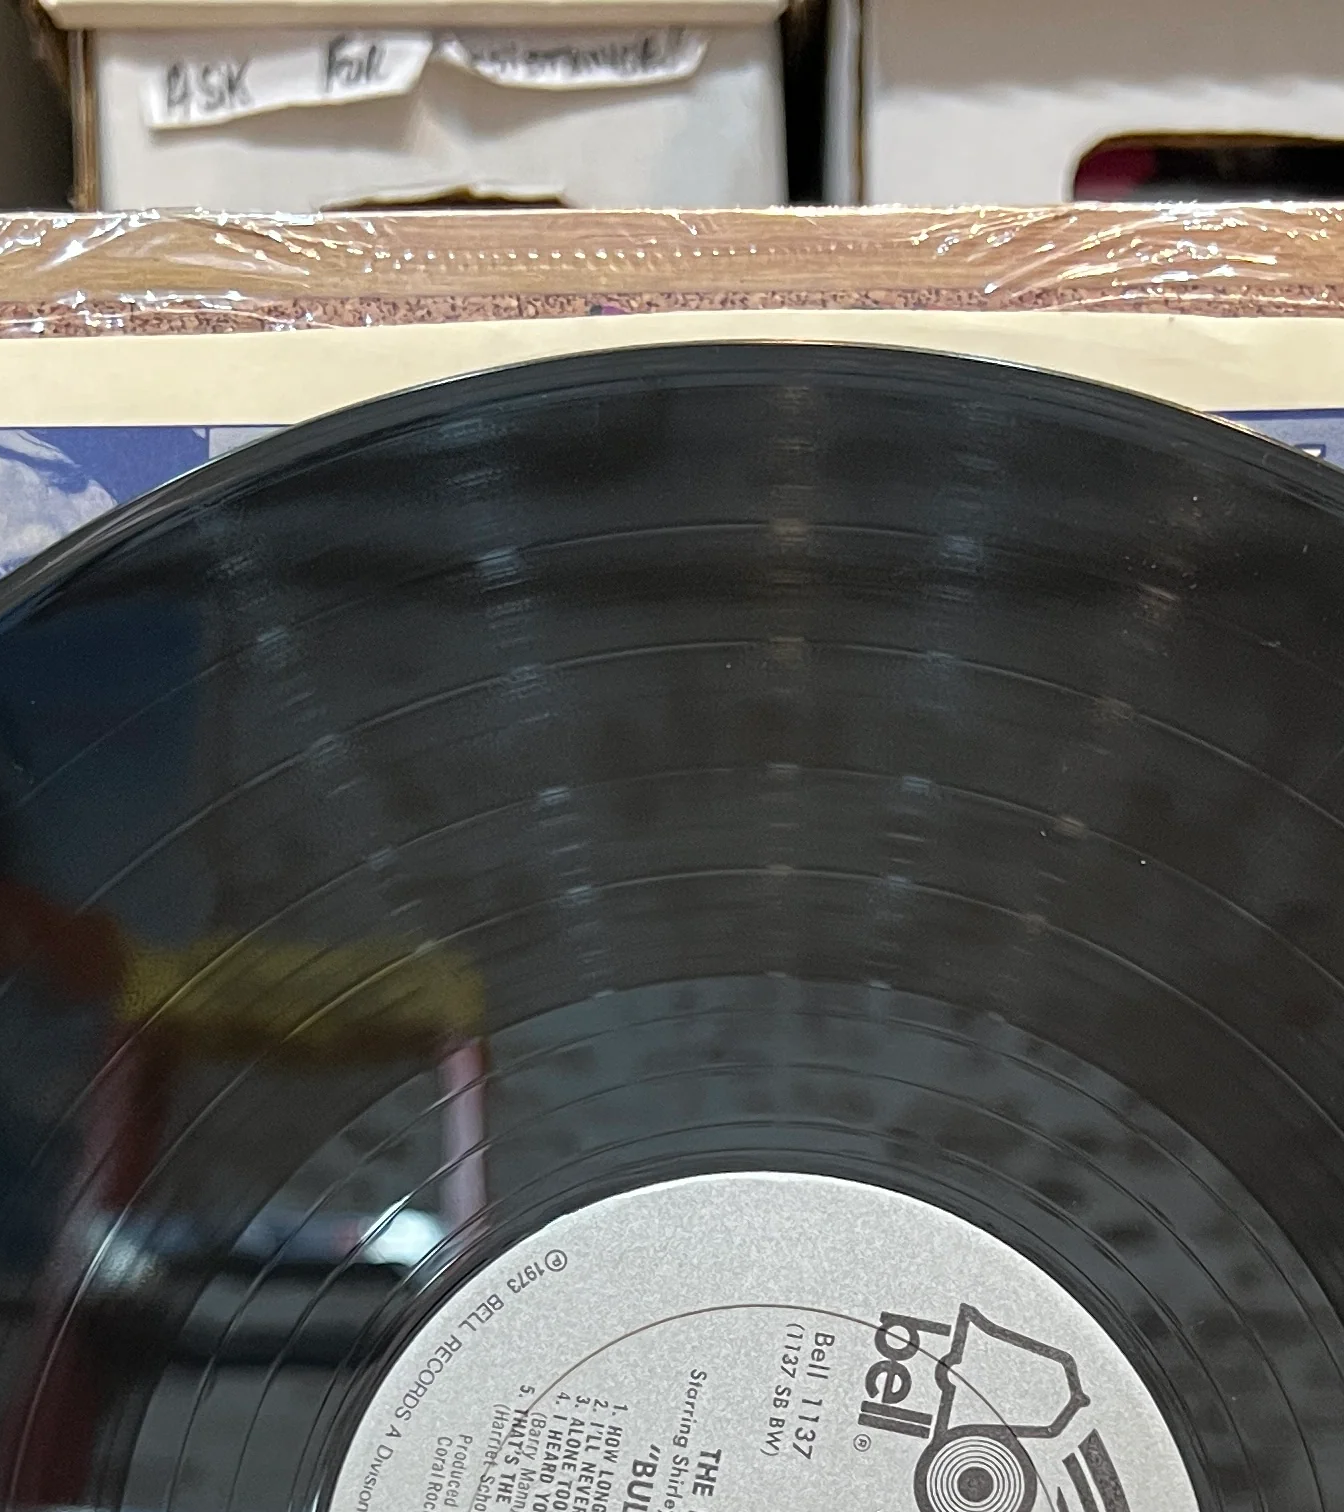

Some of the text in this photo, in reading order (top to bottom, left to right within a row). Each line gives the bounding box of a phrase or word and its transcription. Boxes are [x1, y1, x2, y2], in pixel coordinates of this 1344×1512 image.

[165, 57, 253, 118] ASK
[458, 1294, 505, 1332] BELL
[394, 1334, 463, 1421] RECORDS
[518, 1384, 536, 1398] 5.
[555, 1391, 571, 1405] 4.
[759, 1323, 806, 1457] (1137 SB BW)
[792, 1332, 836, 1460] Bell 1137
[857, 1310, 952, 1440] bell
[574, 1395, 591, 1408] 3.
[592, 1398, 609, 1413] 2.
[611, 1404, 629, 1417] 1.
[672, 1368, 708, 1449] Starring
[385, 1424, 403, 1438] A
[482, 1403, 511, 1468] (Harriet
[504, 1408, 532, 1466] THAT'S
[520, 1412, 548, 1461] (Barry
[561, 1416, 586, 1473] ALONE
[584, 1421, 605, 1452] I'LL
[602, 1425, 623, 1464] HOW
[356, 1444, 394, 1512] Division
[430, 1436, 454, 1479] Coral
[443, 1433, 474, 1508] Produced
[539, 1429, 564, 1484] HEARD
[691, 1448, 722, 1497] THE
[495, 1473, 517, 1505] THE
[552, 1480, 573, 1511] TOO
